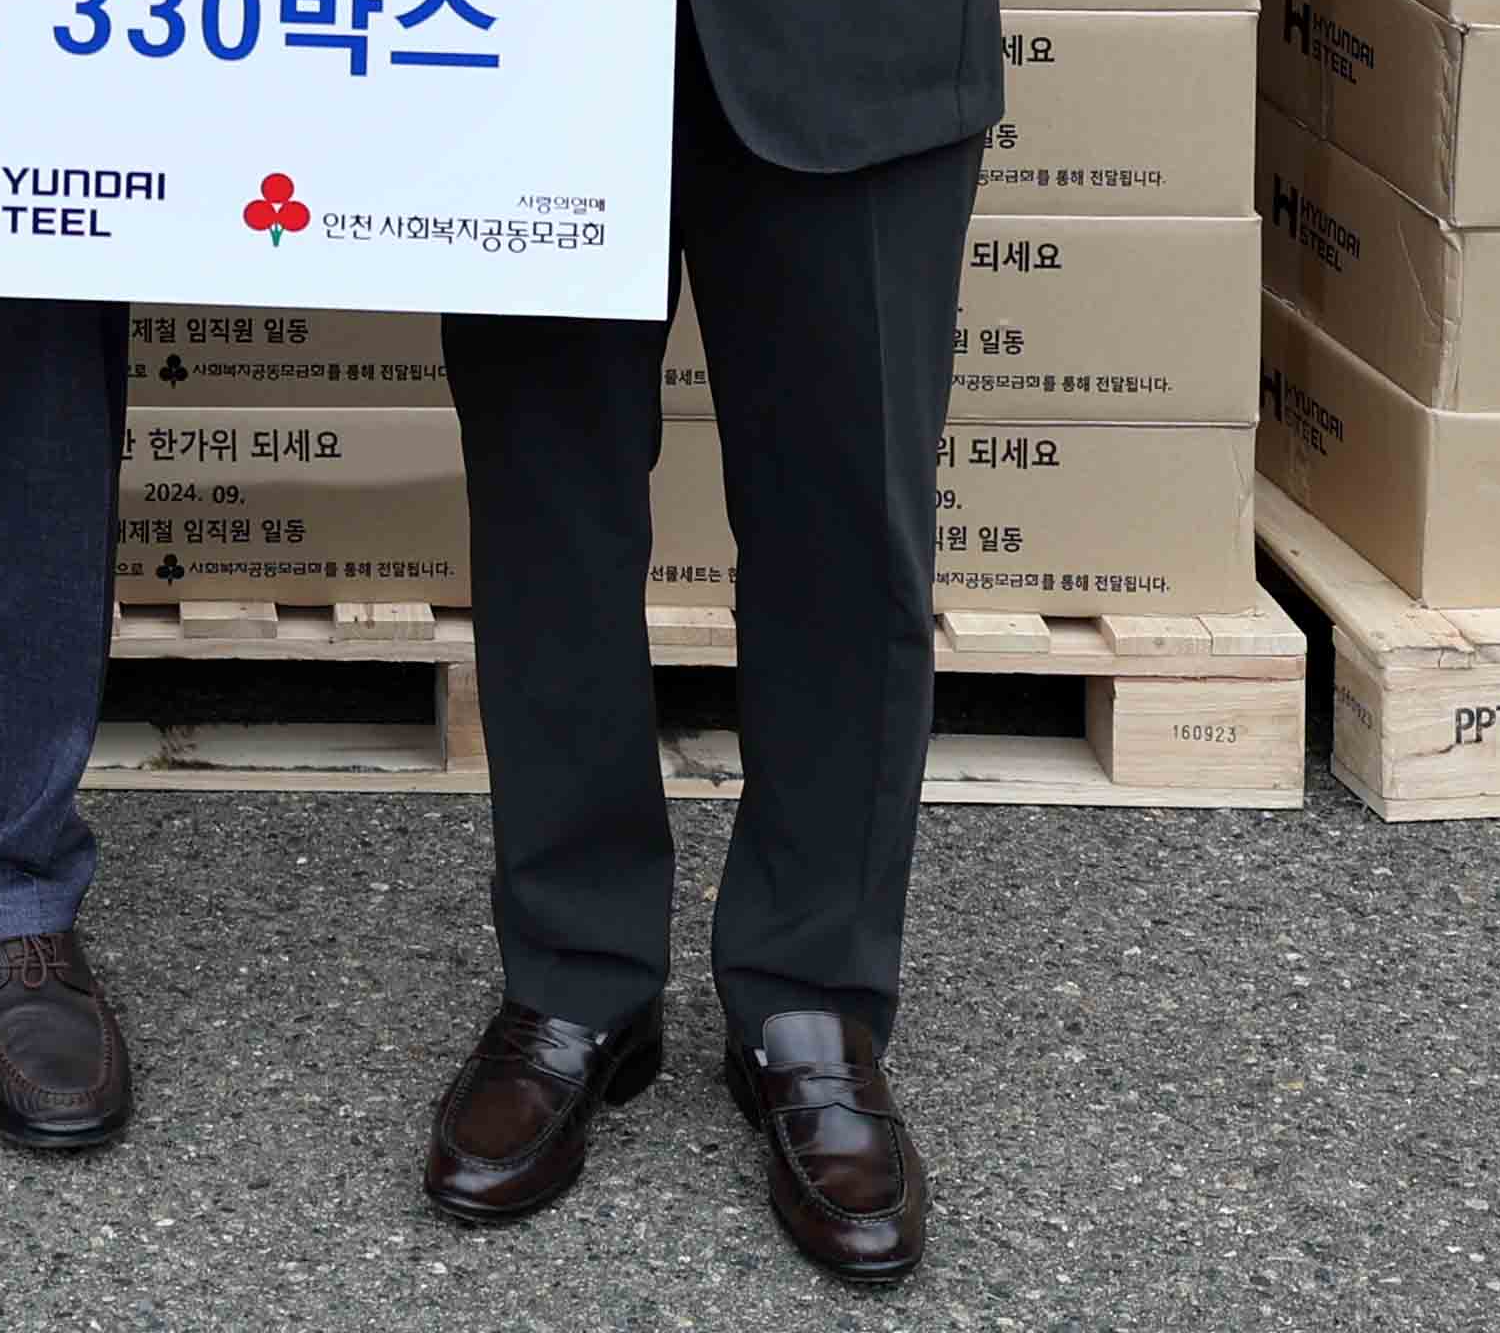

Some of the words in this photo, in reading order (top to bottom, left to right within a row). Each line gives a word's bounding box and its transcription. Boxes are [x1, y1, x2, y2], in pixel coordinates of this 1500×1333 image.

[323, 213, 372, 240] 인천
[380, 211, 604, 253] 사회복지공동모금회
[1171, 723, 1237, 744] 160923
